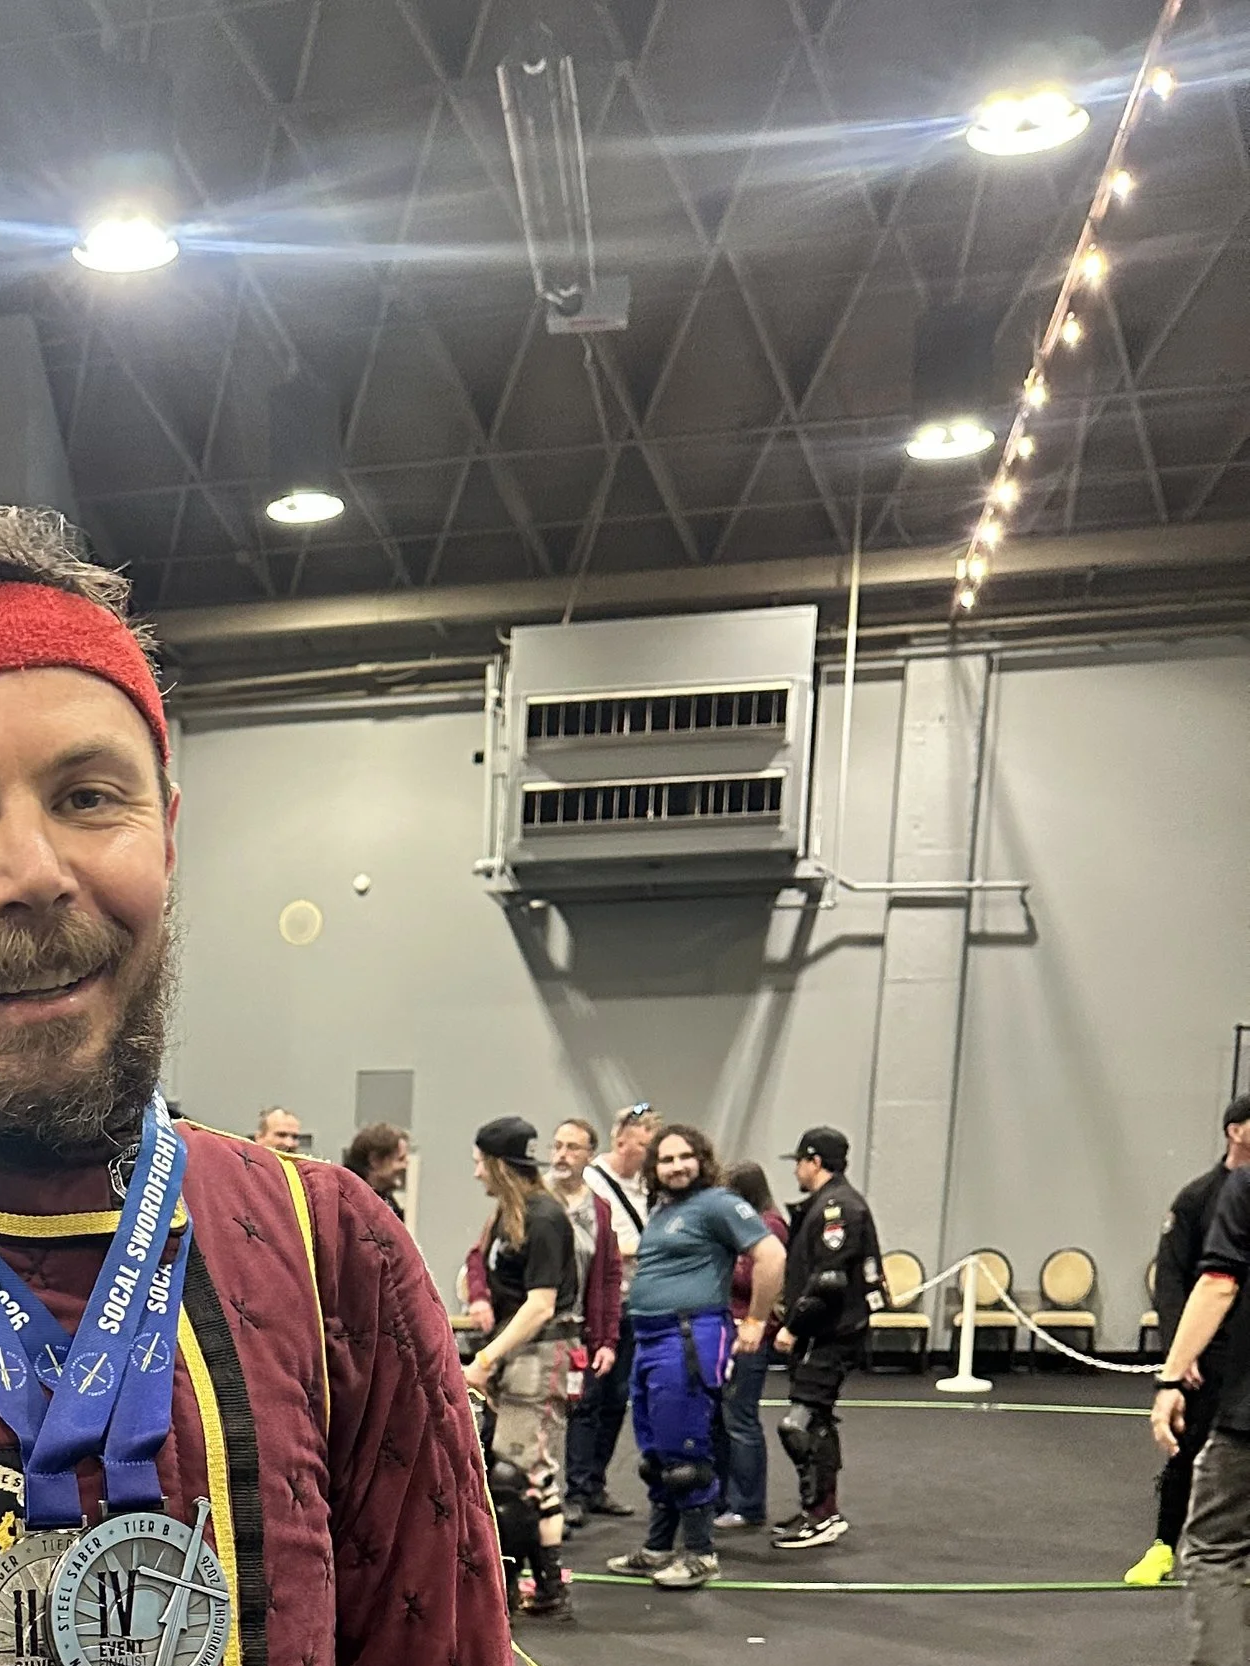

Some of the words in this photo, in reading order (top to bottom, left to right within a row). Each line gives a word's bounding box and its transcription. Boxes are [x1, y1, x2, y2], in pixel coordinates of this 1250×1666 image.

[98, 1264, 141, 1334] SOCAL
[127, 1129, 178, 1262] SWORDFIGHT
[123, 1520, 155, 1534] TIER
[162, 1523, 171, 1536] B
[58, 1586, 72, 1632] STEEL
[68, 1537, 102, 1579] SABER
[201, 1555, 221, 1585] 2026
[97, 1569, 139, 1638] IV
[99, 1639, 144, 1657] EVENT
